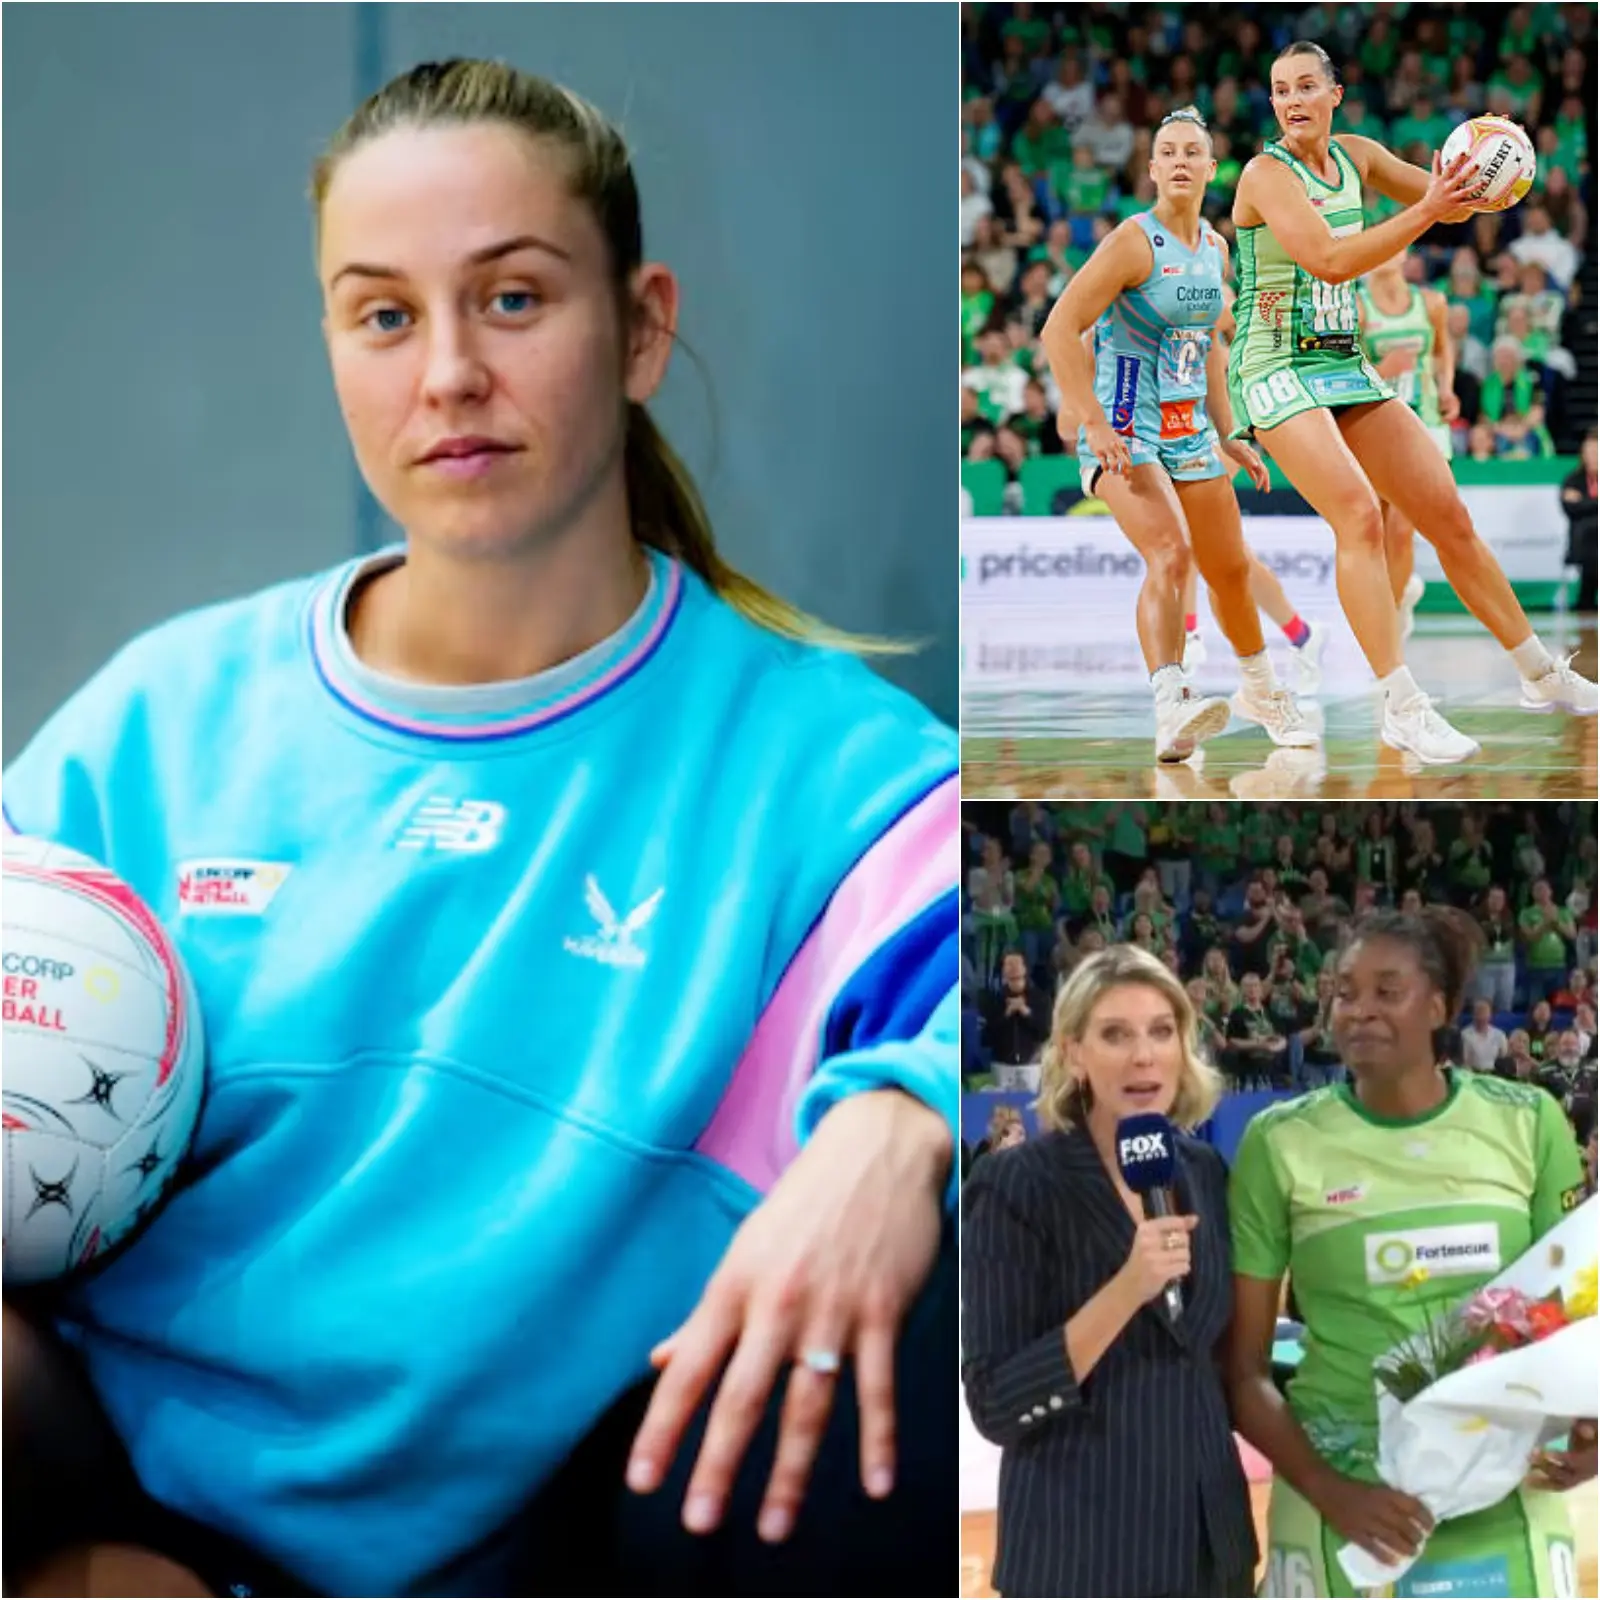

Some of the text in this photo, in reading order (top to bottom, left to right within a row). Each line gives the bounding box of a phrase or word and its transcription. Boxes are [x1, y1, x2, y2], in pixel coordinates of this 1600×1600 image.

[1177, 286, 1221, 302] Cobram
[1250, 369, 1299, 416] 08
[979, 544, 1142, 585] priceline
[1121, 1131, 1168, 1158] FOX
[1416, 1243, 1491, 1260] Fortescue
